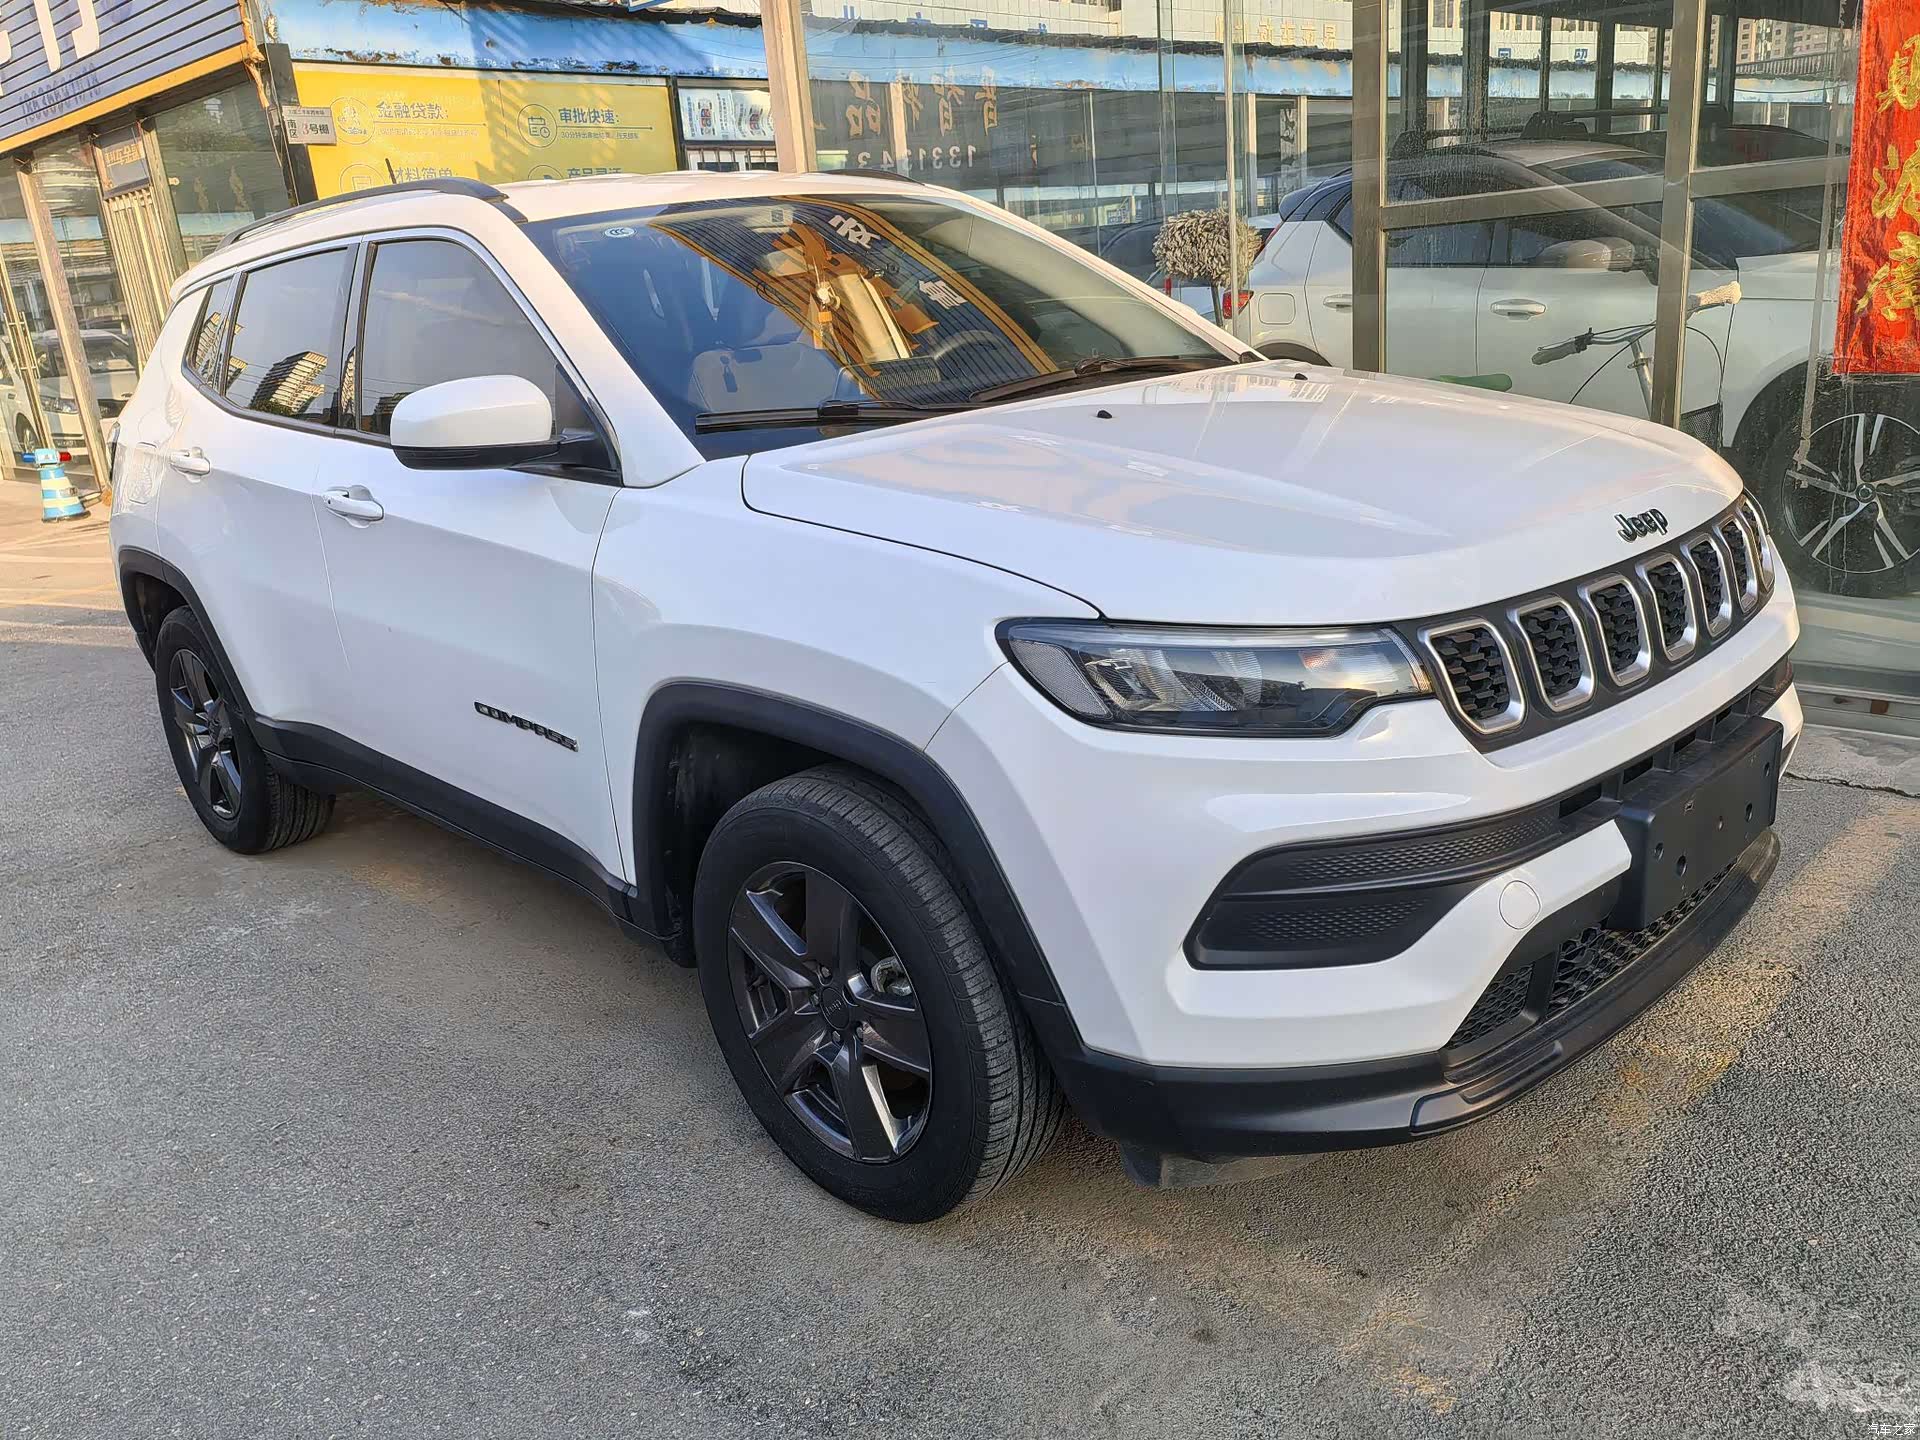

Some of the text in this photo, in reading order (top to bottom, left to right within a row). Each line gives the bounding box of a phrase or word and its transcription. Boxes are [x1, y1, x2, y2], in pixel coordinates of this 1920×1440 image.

[558, 107, 620, 124] 审批快速:
[1614, 508, 1669, 543] Jeep
[474, 701, 579, 752] COMPASS
